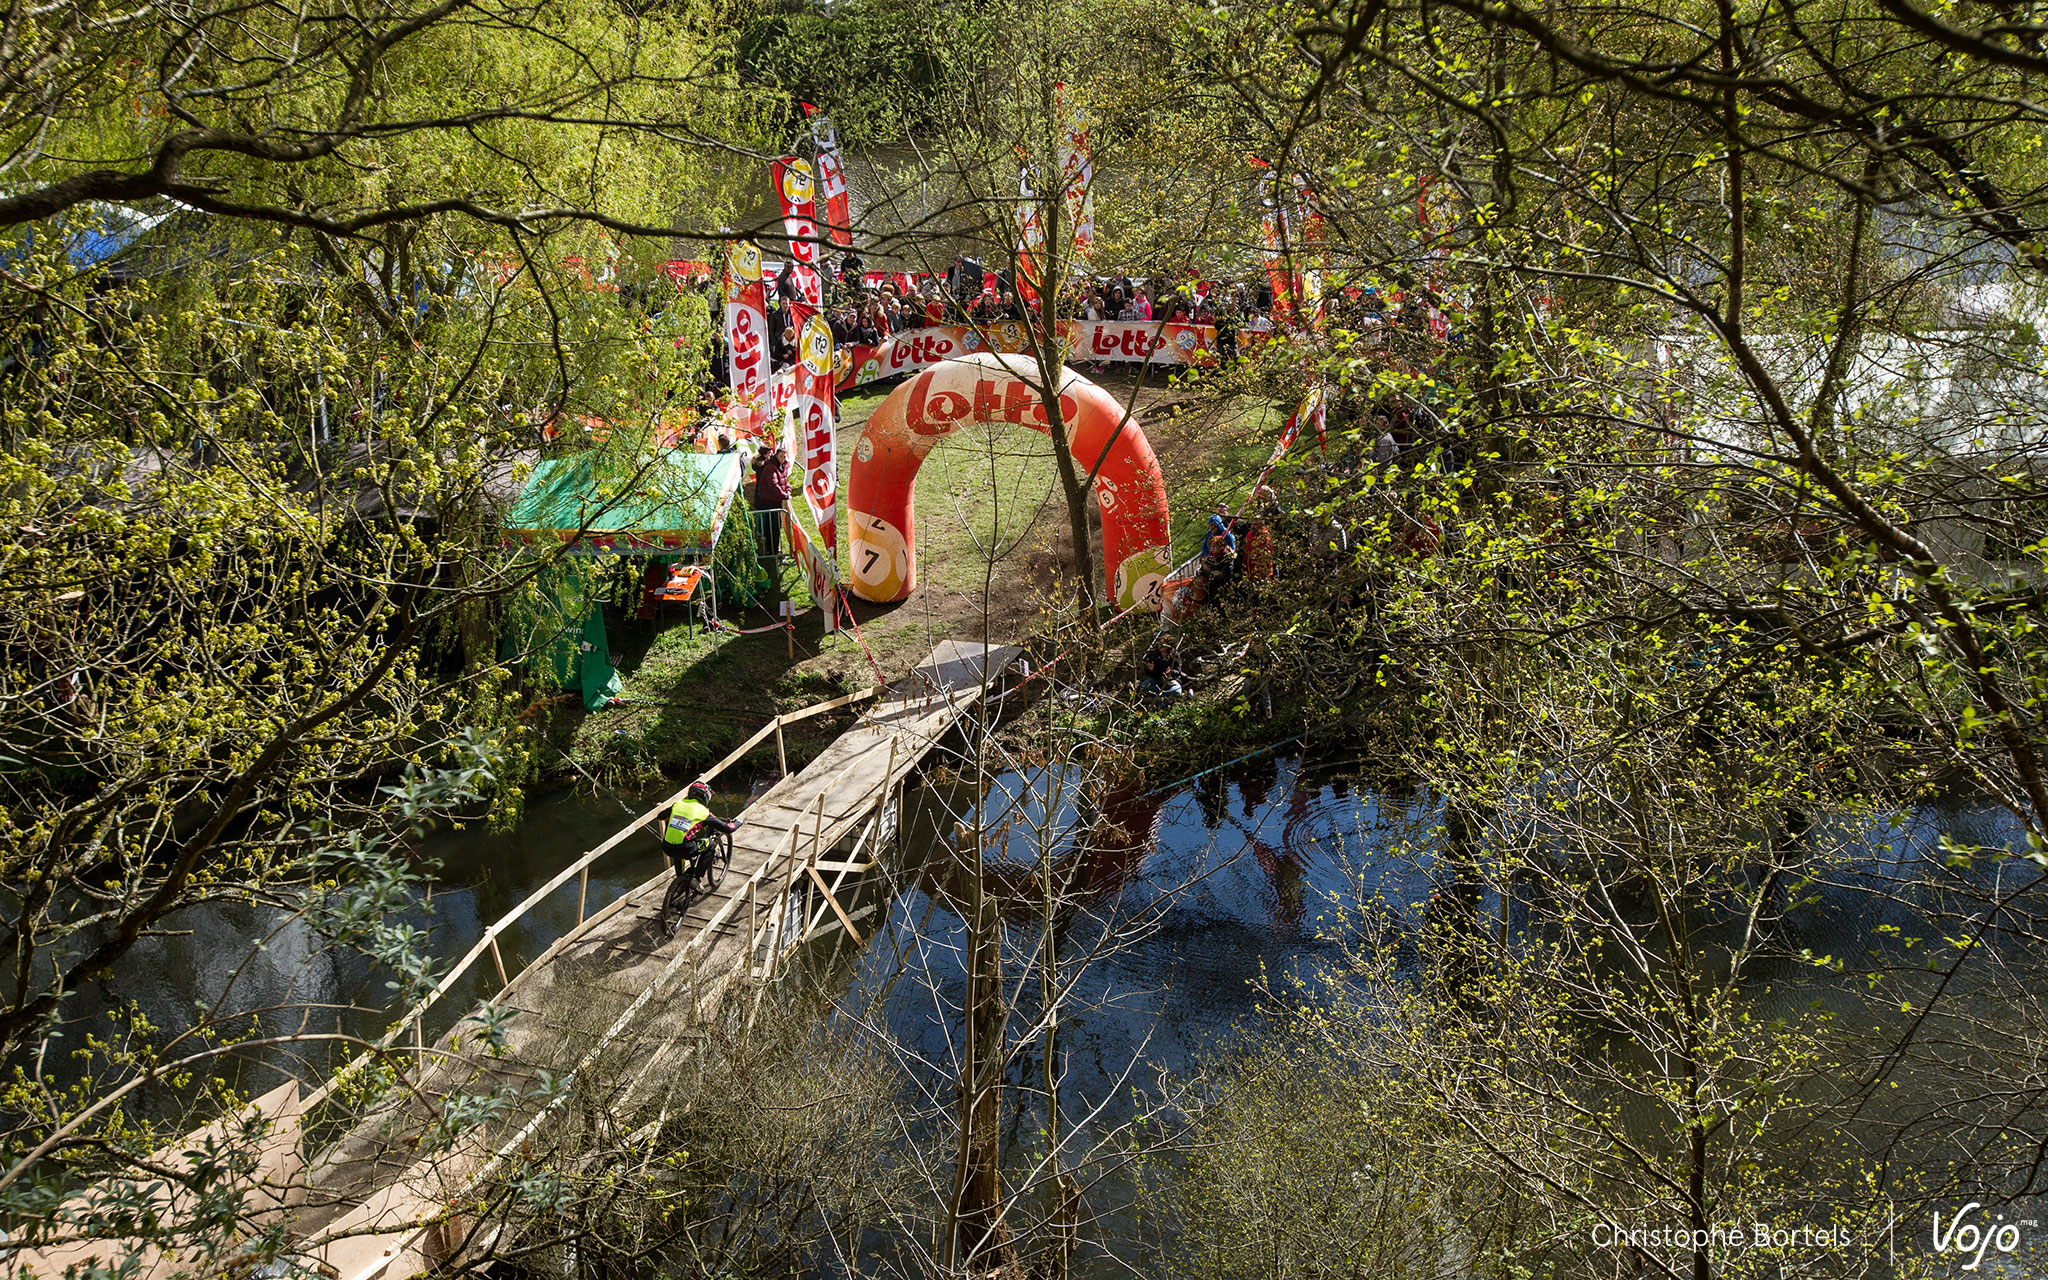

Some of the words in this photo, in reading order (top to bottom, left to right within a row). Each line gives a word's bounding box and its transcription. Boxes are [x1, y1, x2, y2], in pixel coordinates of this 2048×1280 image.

[890, 335, 954, 369] Lotto
[1091, 326, 1167, 357] Lotto
[905, 371, 1079, 435] Lotto
[862, 549, 880, 574] 7
